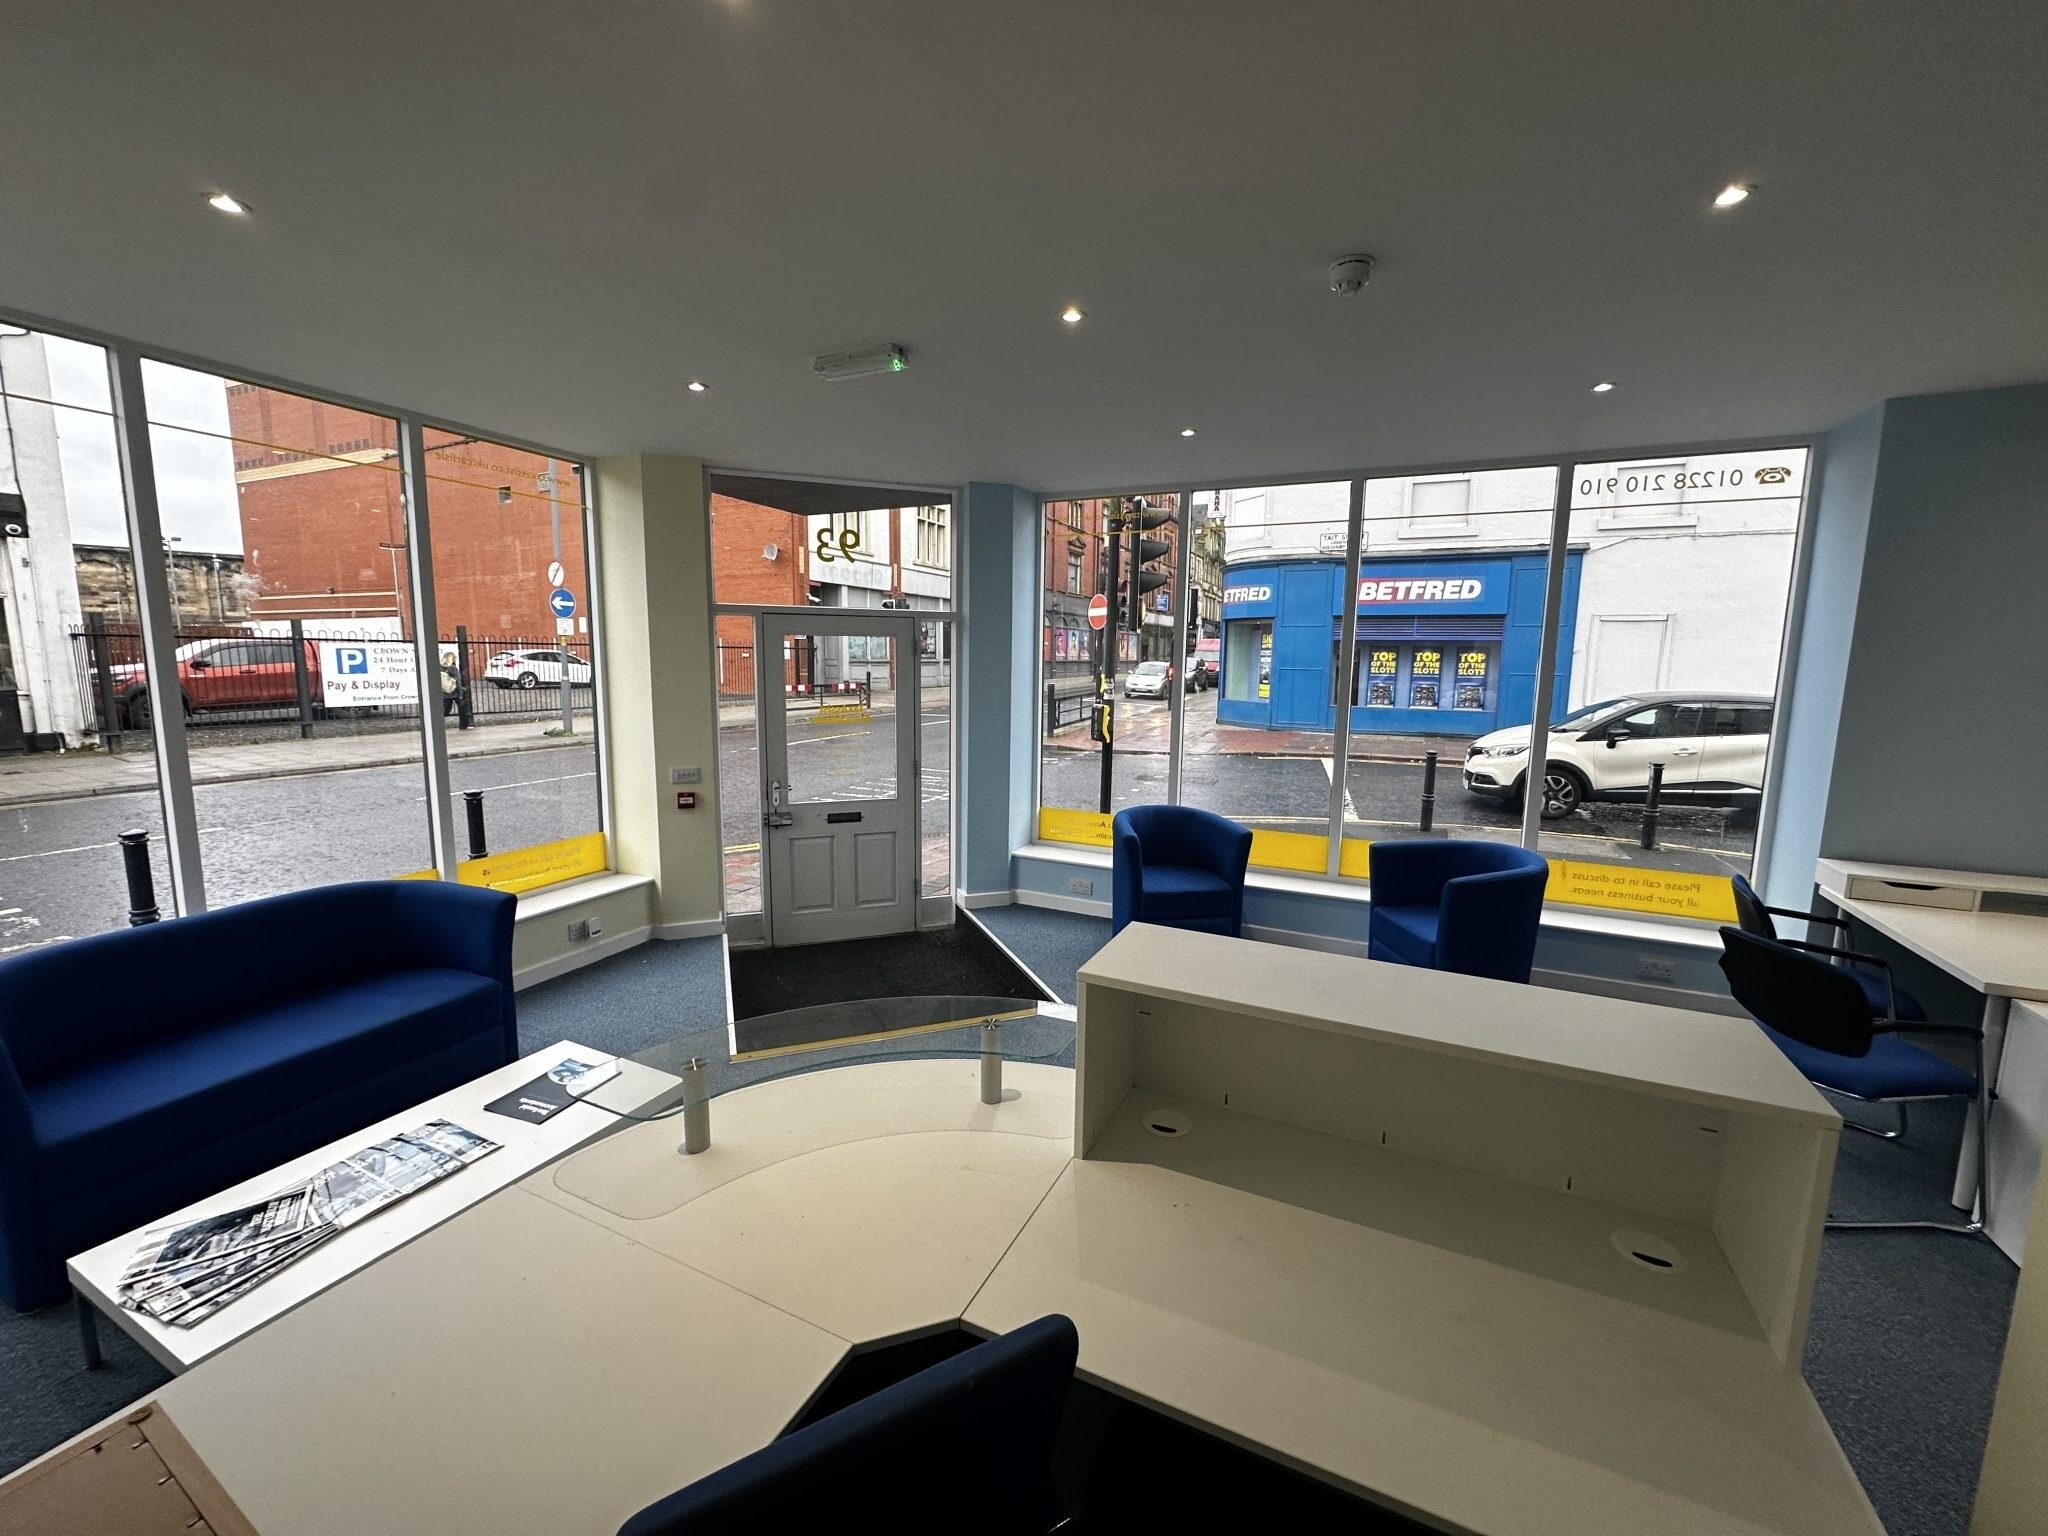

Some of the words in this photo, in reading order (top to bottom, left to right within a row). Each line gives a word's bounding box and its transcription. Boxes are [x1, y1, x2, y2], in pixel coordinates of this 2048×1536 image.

[1224, 586, 1271, 603] ETFRED
[1358, 579, 1482, 601] BETFRED
[340, 649, 364, 674] P
[1371, 652, 1397, 661] TOP
[1414, 652, 1440, 662] TOP
[1460, 652, 1486, 662] TOP
[1457, 668, 1486, 676] SLOTS
[327, 681, 347, 692] Pay
[351, 681, 359, 690] &
[363, 680, 401, 692] Display
